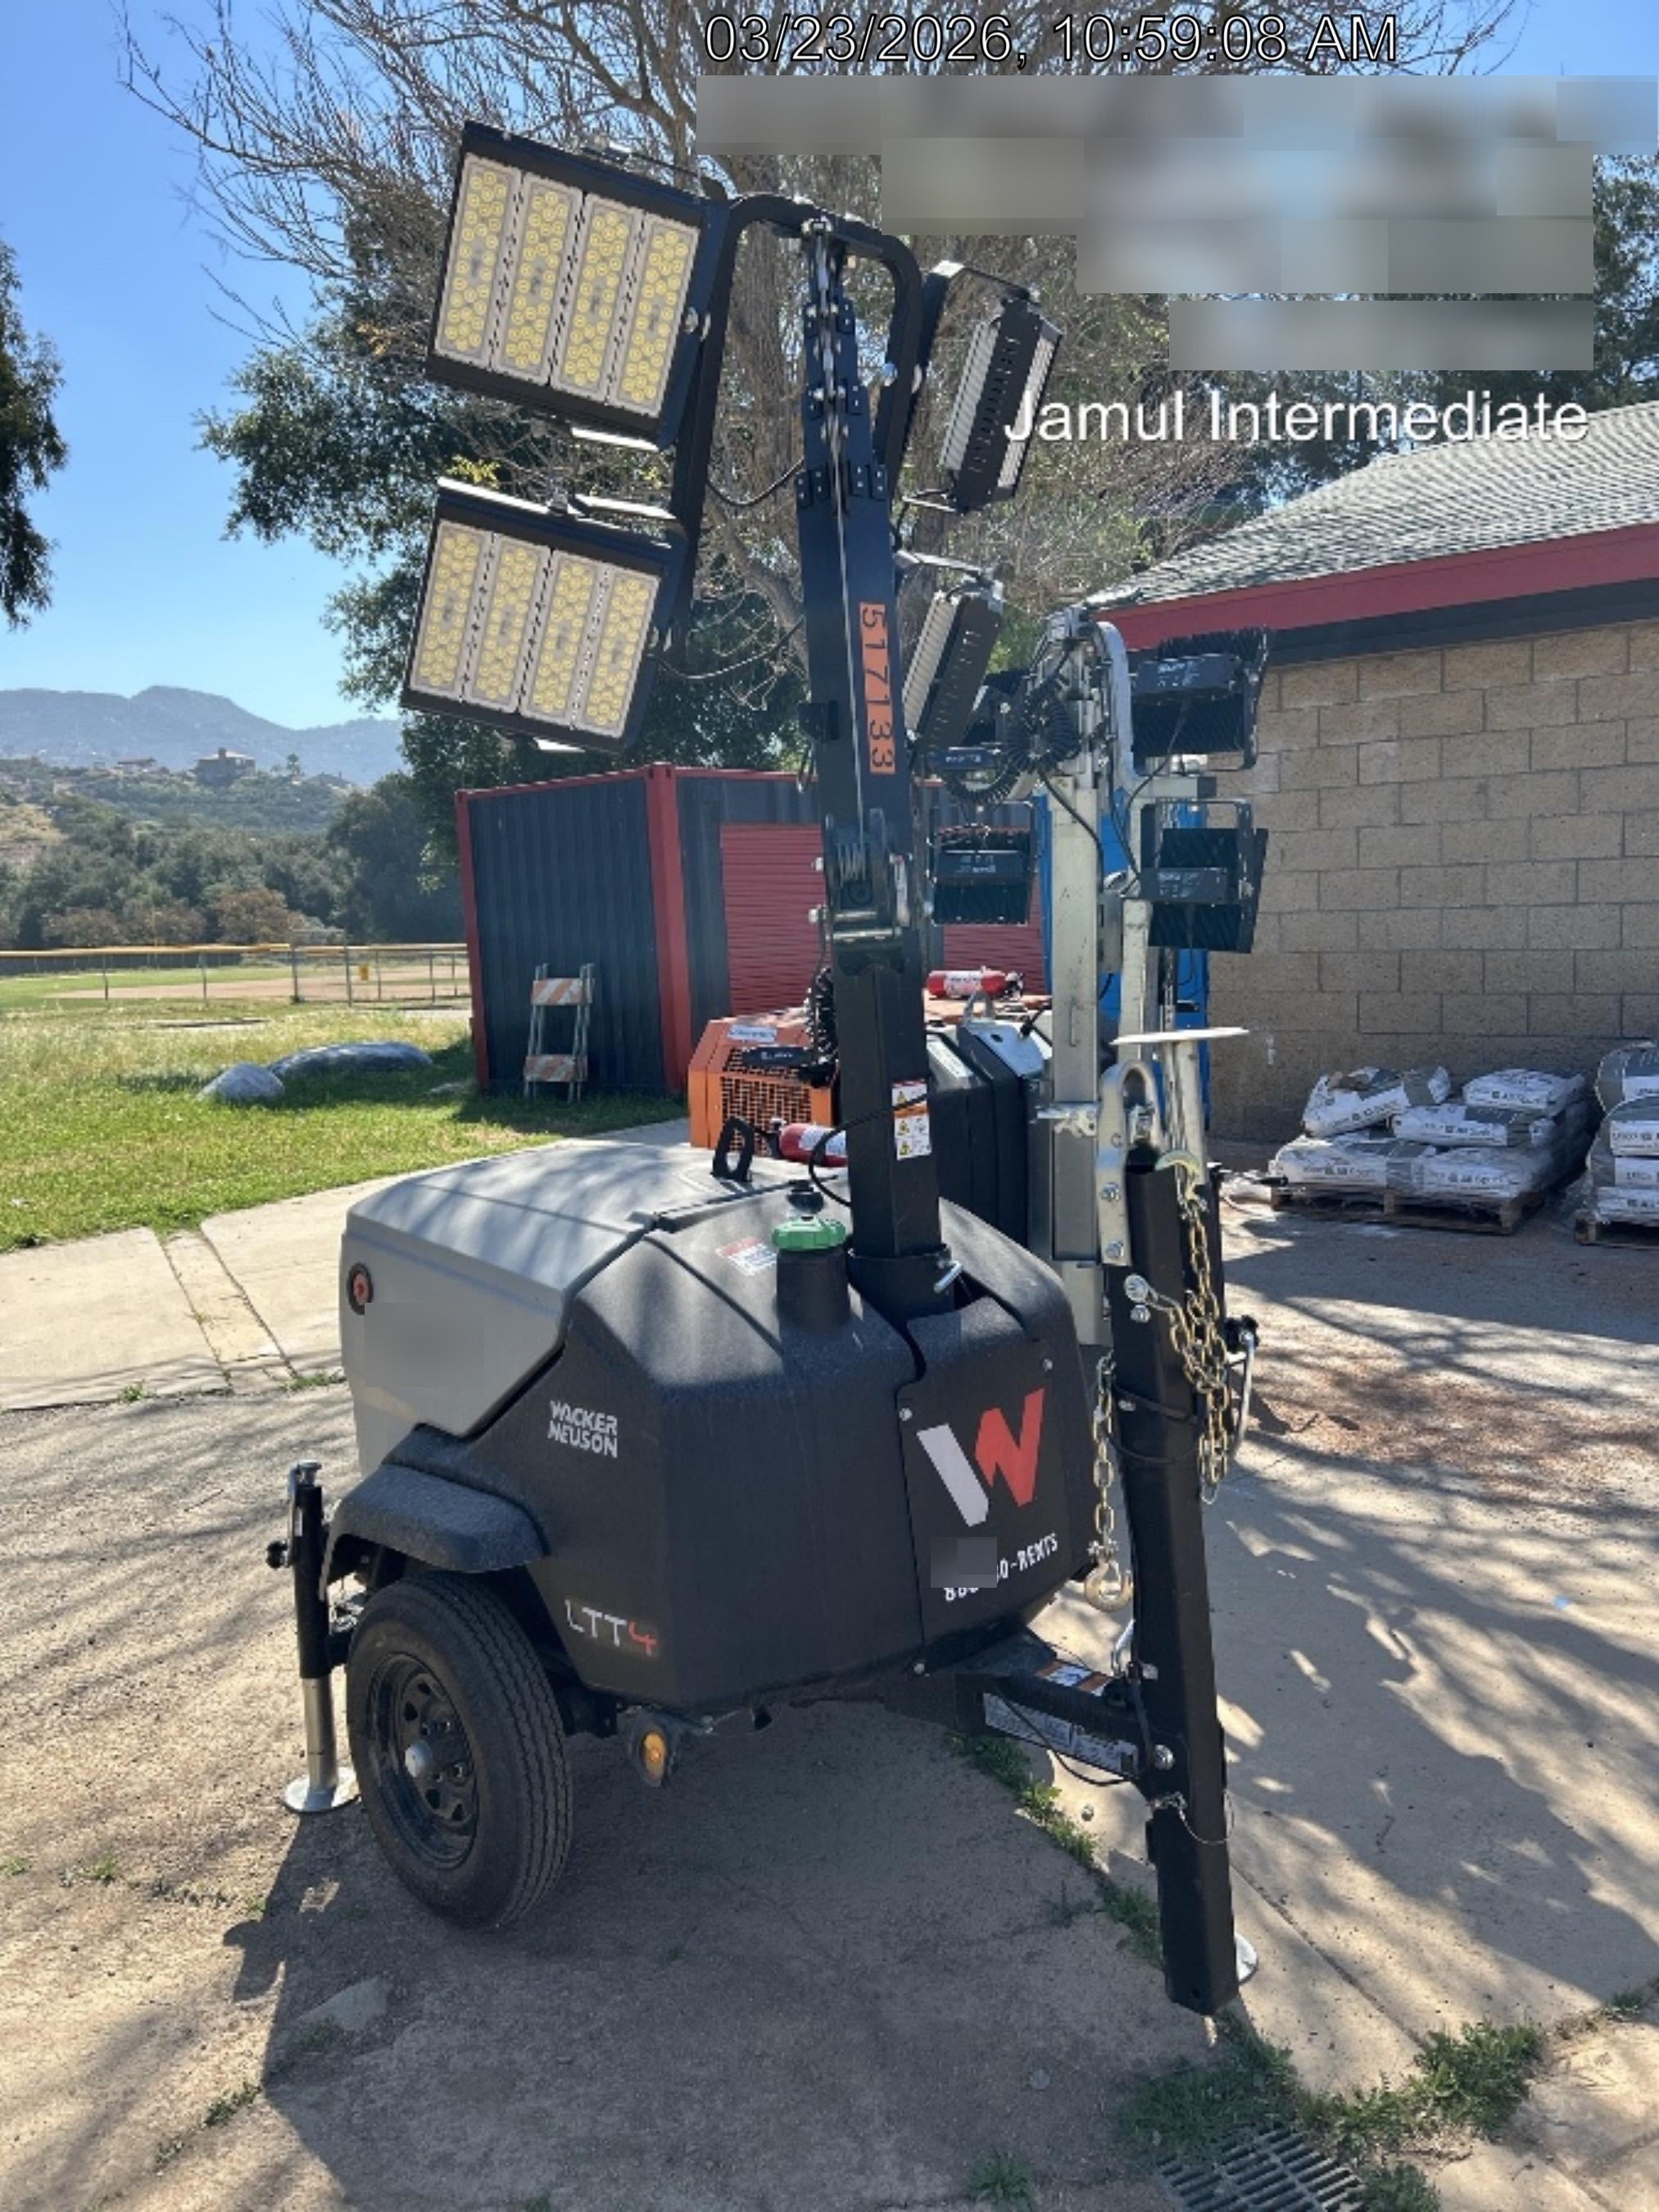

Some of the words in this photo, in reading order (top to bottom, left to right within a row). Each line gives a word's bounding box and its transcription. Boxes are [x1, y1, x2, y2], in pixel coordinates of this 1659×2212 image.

[862, 605, 895, 768] 517133
[547, 1420, 618, 1458] NEUSON
[549, 1399, 618, 1437] WACKER
[564, 1598, 657, 1656] LTT4
